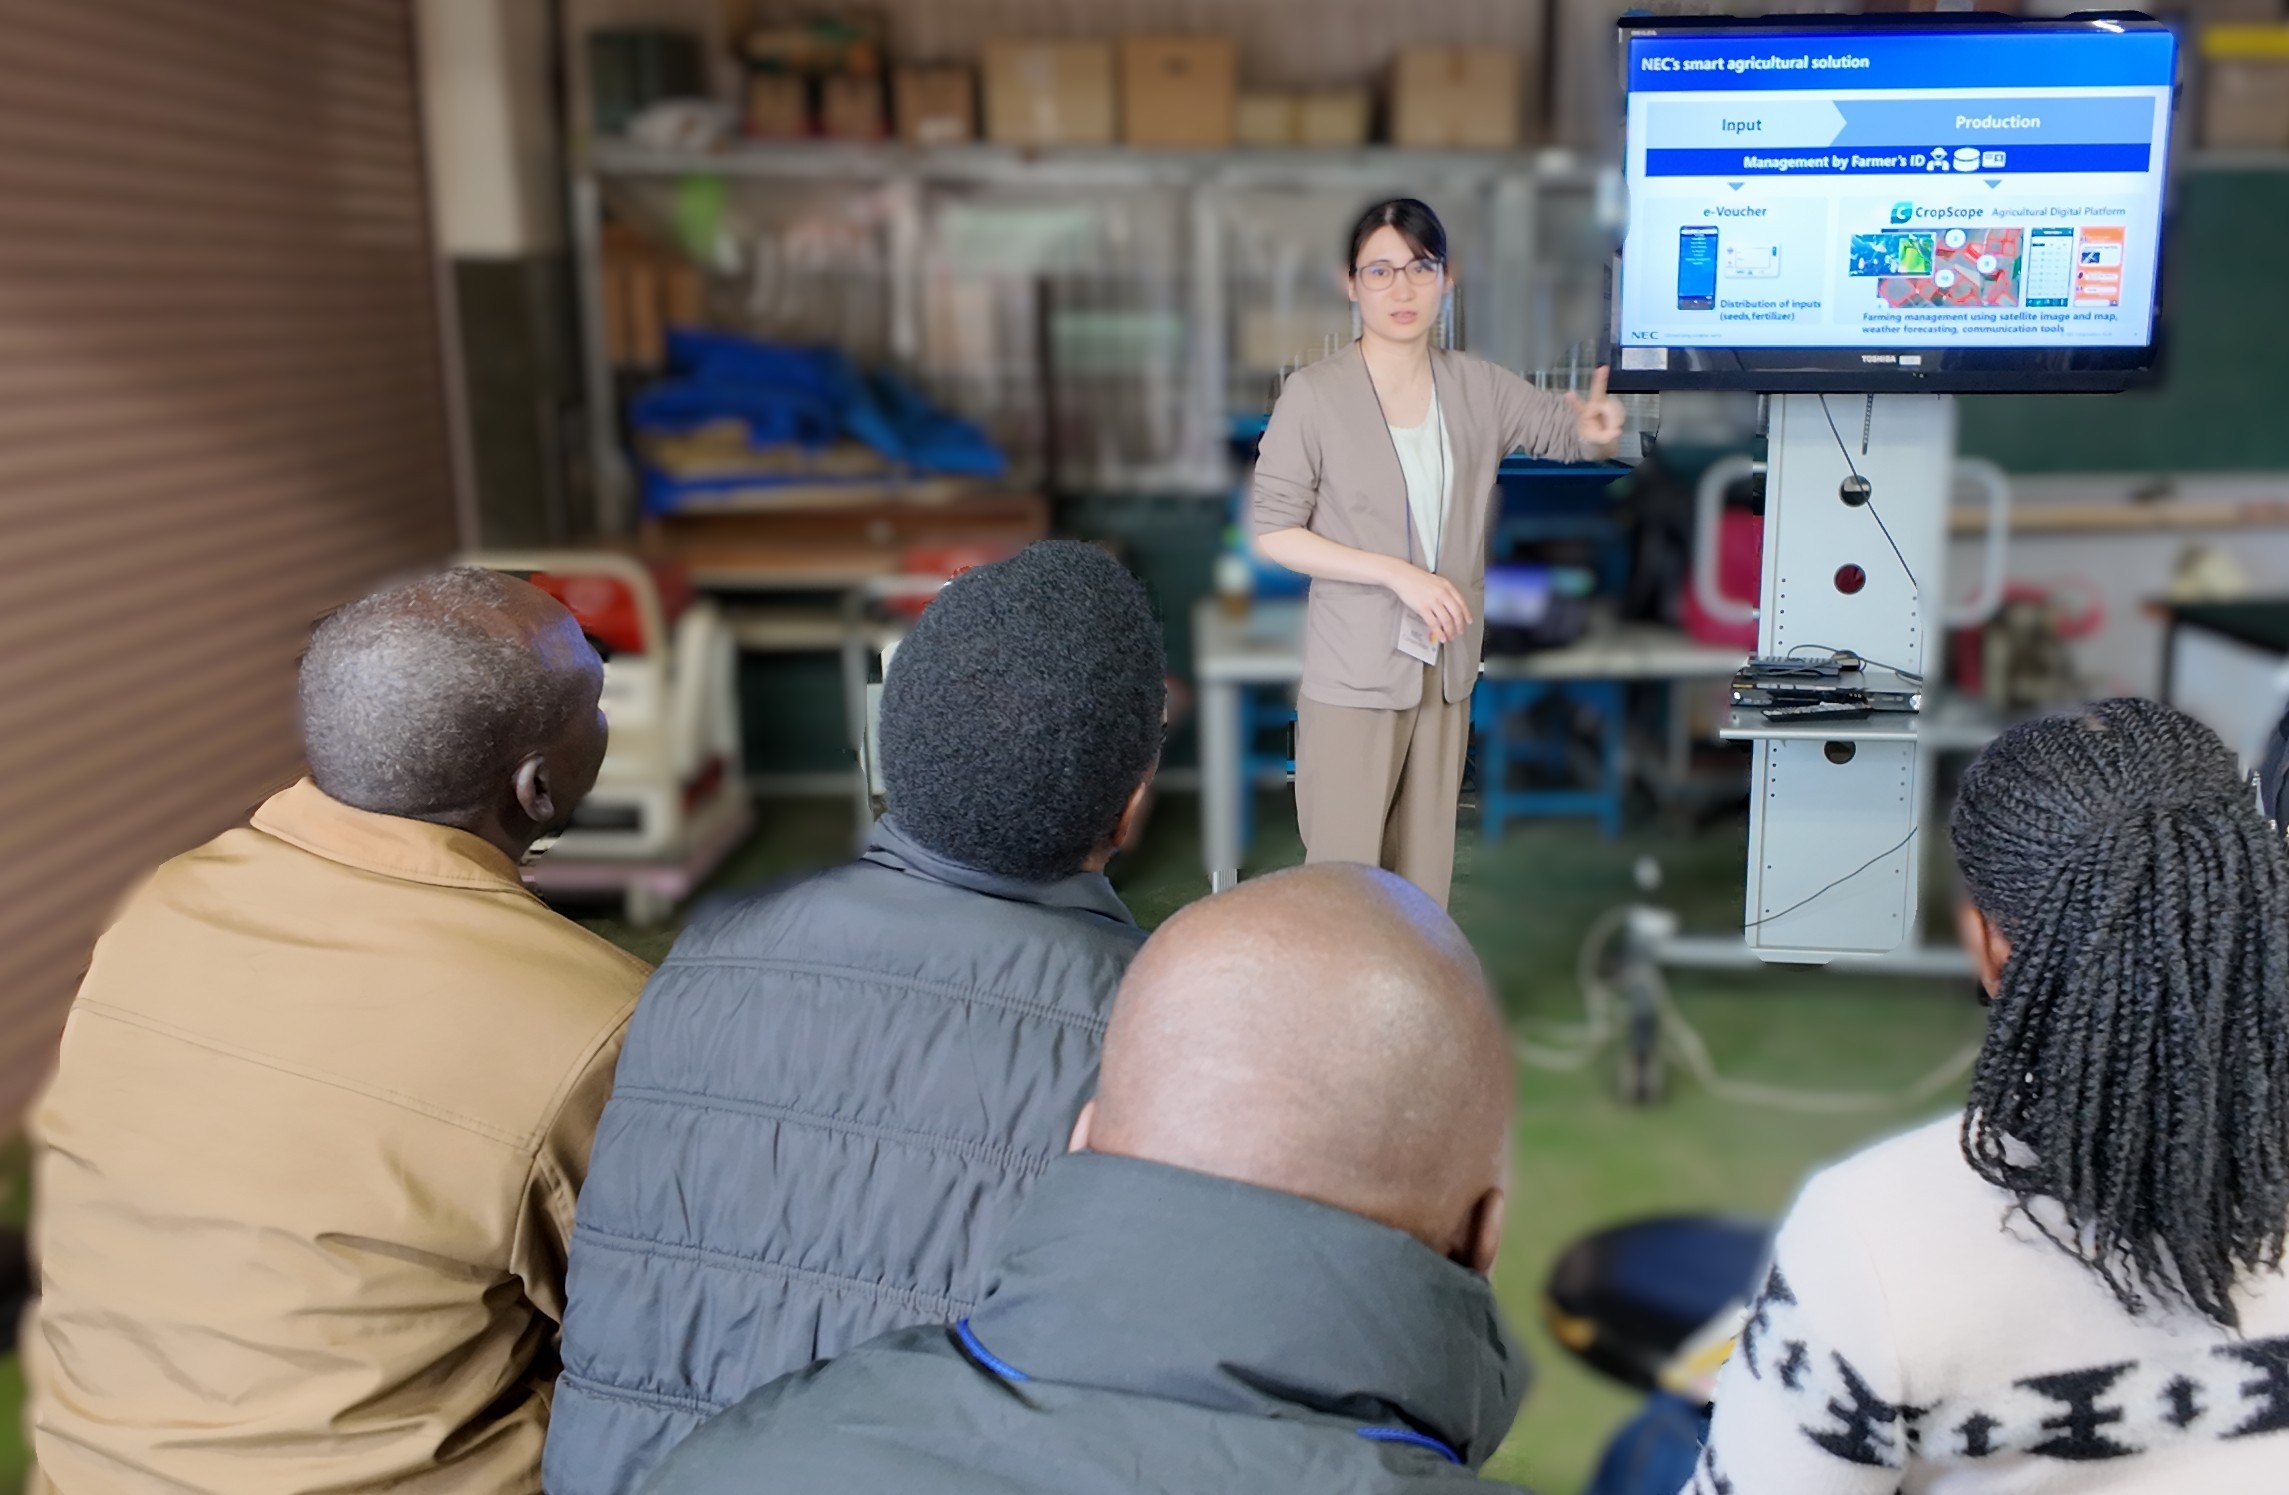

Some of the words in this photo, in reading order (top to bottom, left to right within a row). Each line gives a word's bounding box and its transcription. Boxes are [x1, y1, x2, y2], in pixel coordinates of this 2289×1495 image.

[1641, 57, 1680, 71] NEC's
[1683, 57, 1725, 71] smart
[1727, 55, 1808, 73] agricultural
[1811, 54, 1870, 69] solution
[1722, 119, 1762, 134] Input
[1955, 115, 2040, 129] Production
[1743, 155, 1829, 171] Management
[1832, 155, 1849, 170] by
[1852, 154, 1907, 168] Farmer's
[1910, 154, 1926, 167] ID
[1703, 205, 1767, 217] e-Voucher
[1915, 206, 1984, 219] CropScope
[1992, 207, 2048, 218] Agricultural
[2050, 207, 2082, 218] Digital
[2084, 206, 2126, 216] Platform
[1720, 299, 1777, 308] Distribution
[1779, 299, 1790, 308] of
[1792, 299, 1821, 310] inputs
[1863, 312, 1902, 322] Farming
[1905, 312, 1968, 322] management
[1970, 312, 1997, 323] using
[2000, 312, 2038, 320] satellite
[2040, 312, 2070, 322] image
[2073, 312, 2091, 320] and
[1862, 324, 1900, 333] weather
[1962, 324, 2038, 334] communication
[2041, 324, 2065, 333] tools
[1631, 331, 1659, 340] NEC
